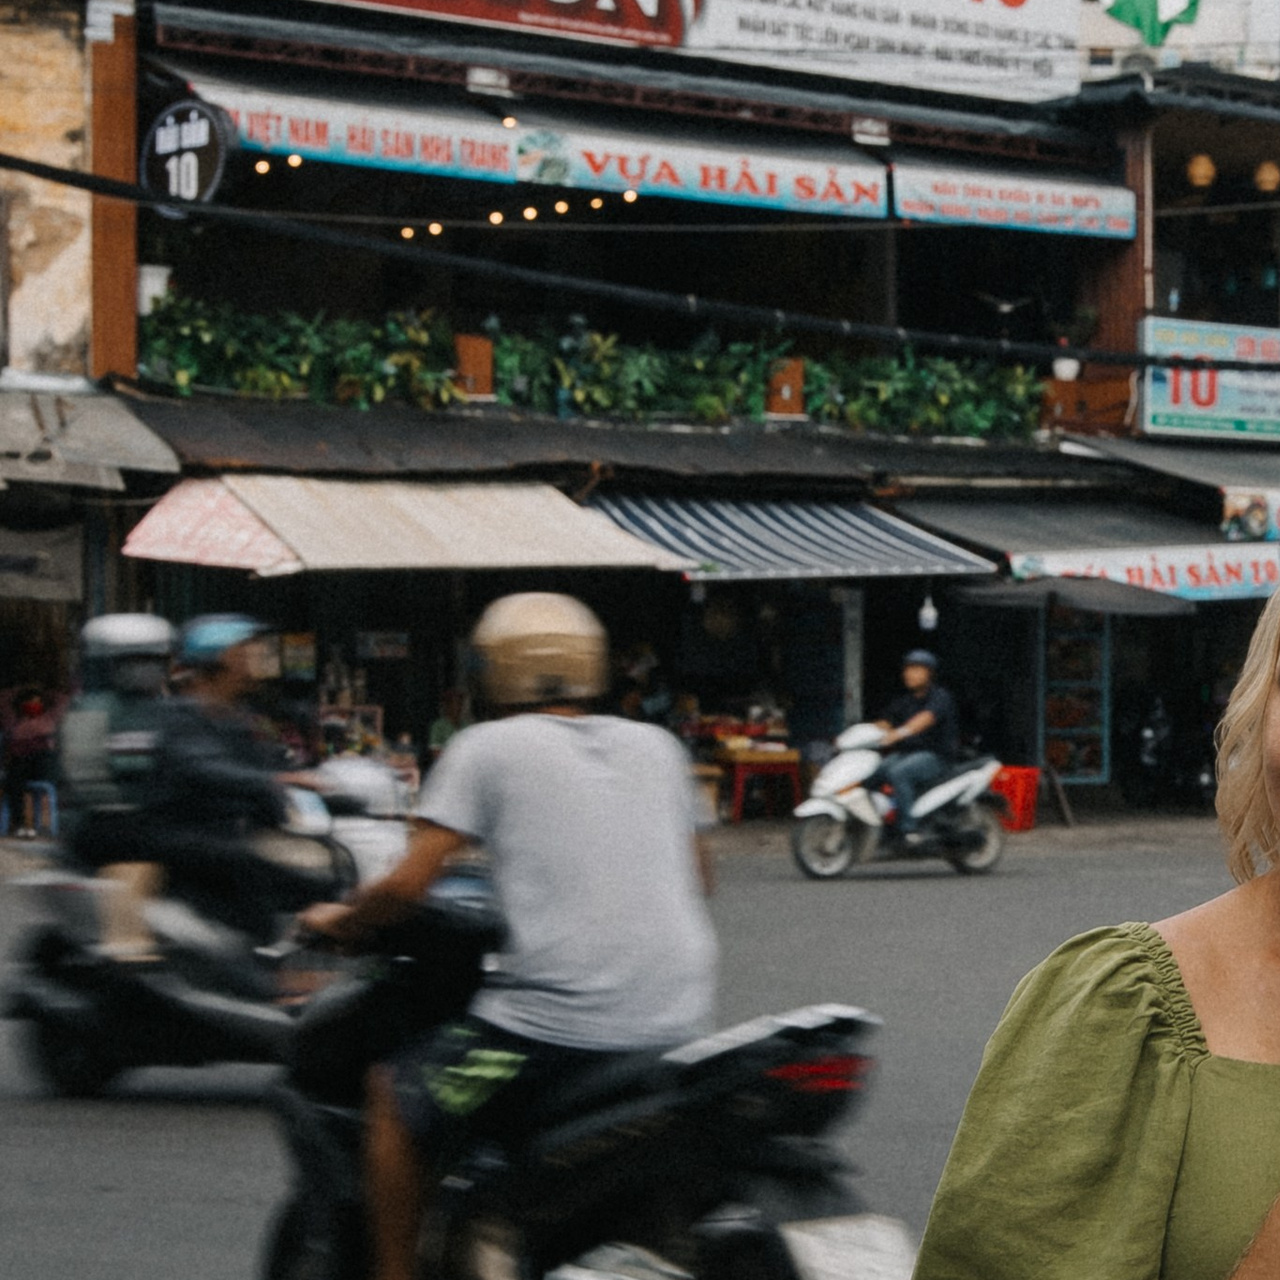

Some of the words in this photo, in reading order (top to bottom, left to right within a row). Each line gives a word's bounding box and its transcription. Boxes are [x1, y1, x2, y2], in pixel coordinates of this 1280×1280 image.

[165, 151, 199, 201] 10
[582, 150, 682, 187] VỰA
[700, 159, 778, 197] HẢI
[794, 167, 880, 205] SẢN
